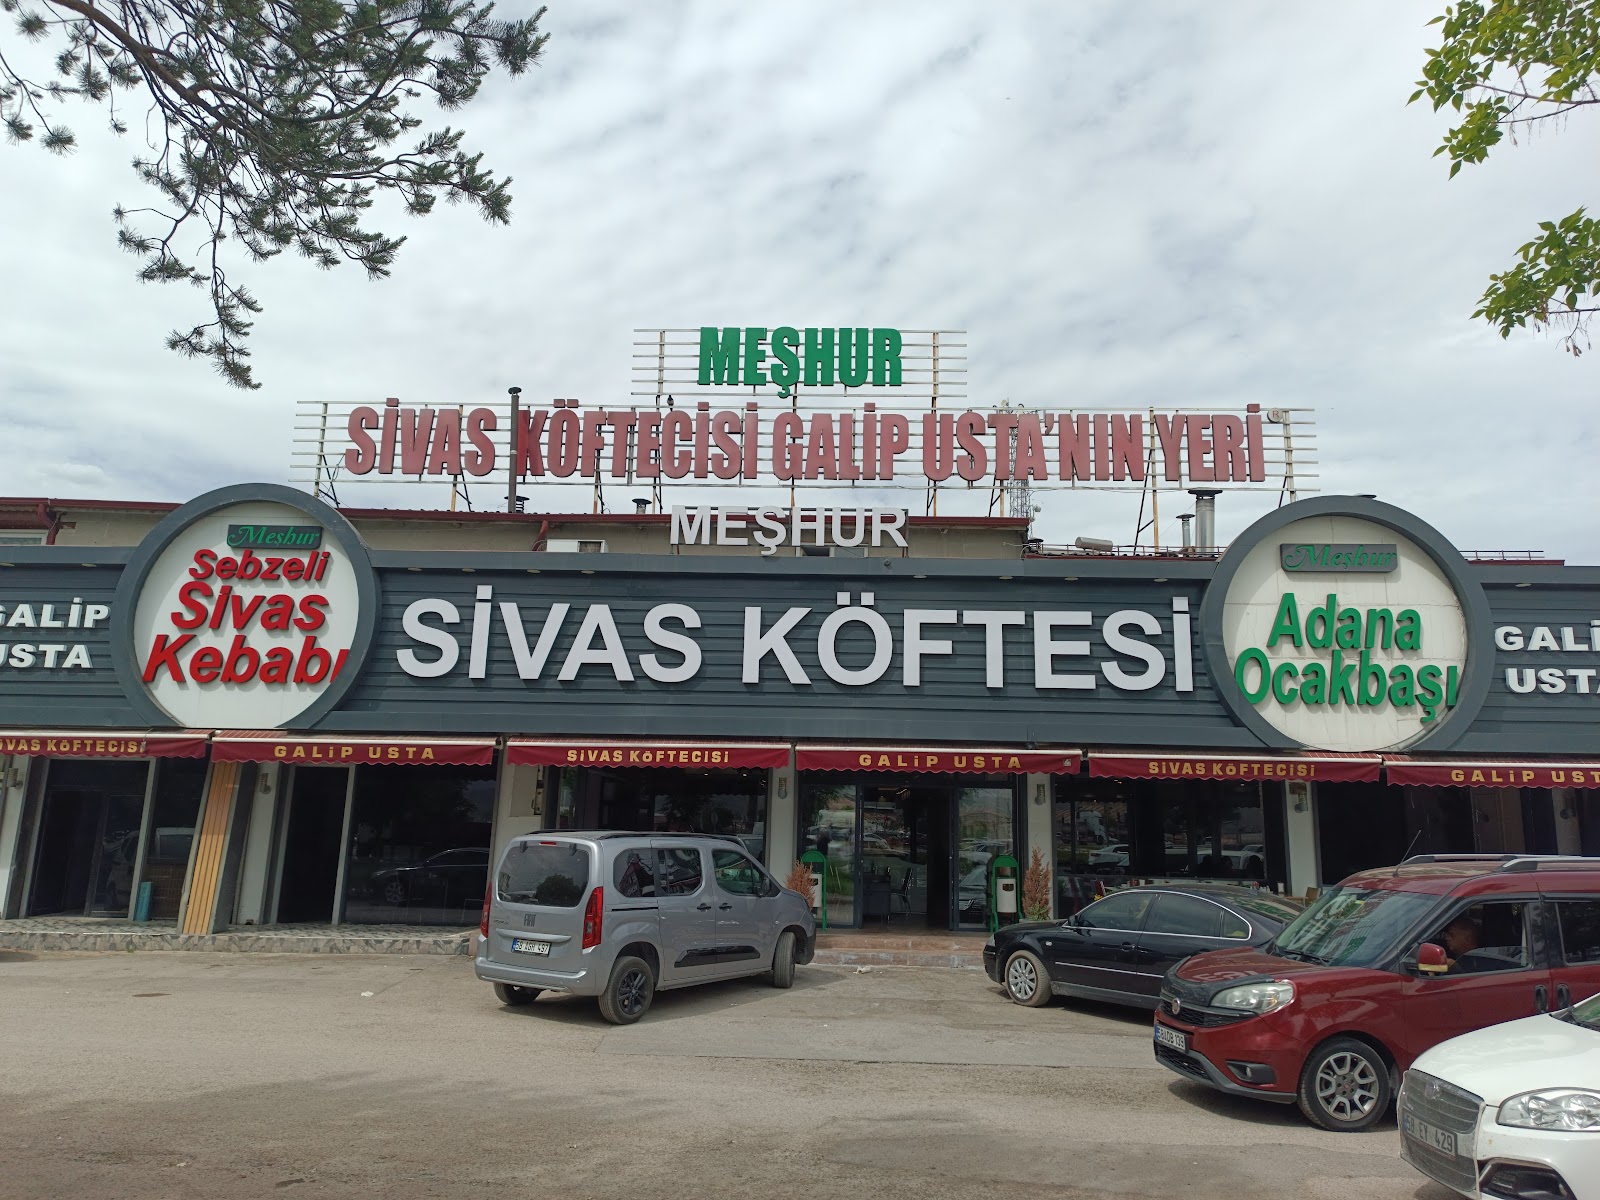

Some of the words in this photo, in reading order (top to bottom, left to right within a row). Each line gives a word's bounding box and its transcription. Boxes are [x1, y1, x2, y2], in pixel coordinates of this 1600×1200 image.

[698, 326, 902, 398] MEŞHUR
[345, 397, 497, 477] SİVAS
[772, 402, 910, 481] GALİP
[1154, 403, 1266, 483] YERİ
[670, 504, 909, 556] MEŞHUR
[189, 548, 331, 582] Sebzeli
[0, 597, 111, 629] ALİP
[170, 580, 330, 631] Sivas
[1266, 592, 1422, 651] Adana
[396, 584, 702, 683] SİVAS
[741, 591, 1194, 692] KÖFTESİ
[1504, 667, 1600, 694] UST
[368, 746, 435, 760] USTA
[953, 756, 1021, 769] USTA
[1419, 1121, 1428, 1141] EY
[1435, 1129, 1453, 1152] 429
